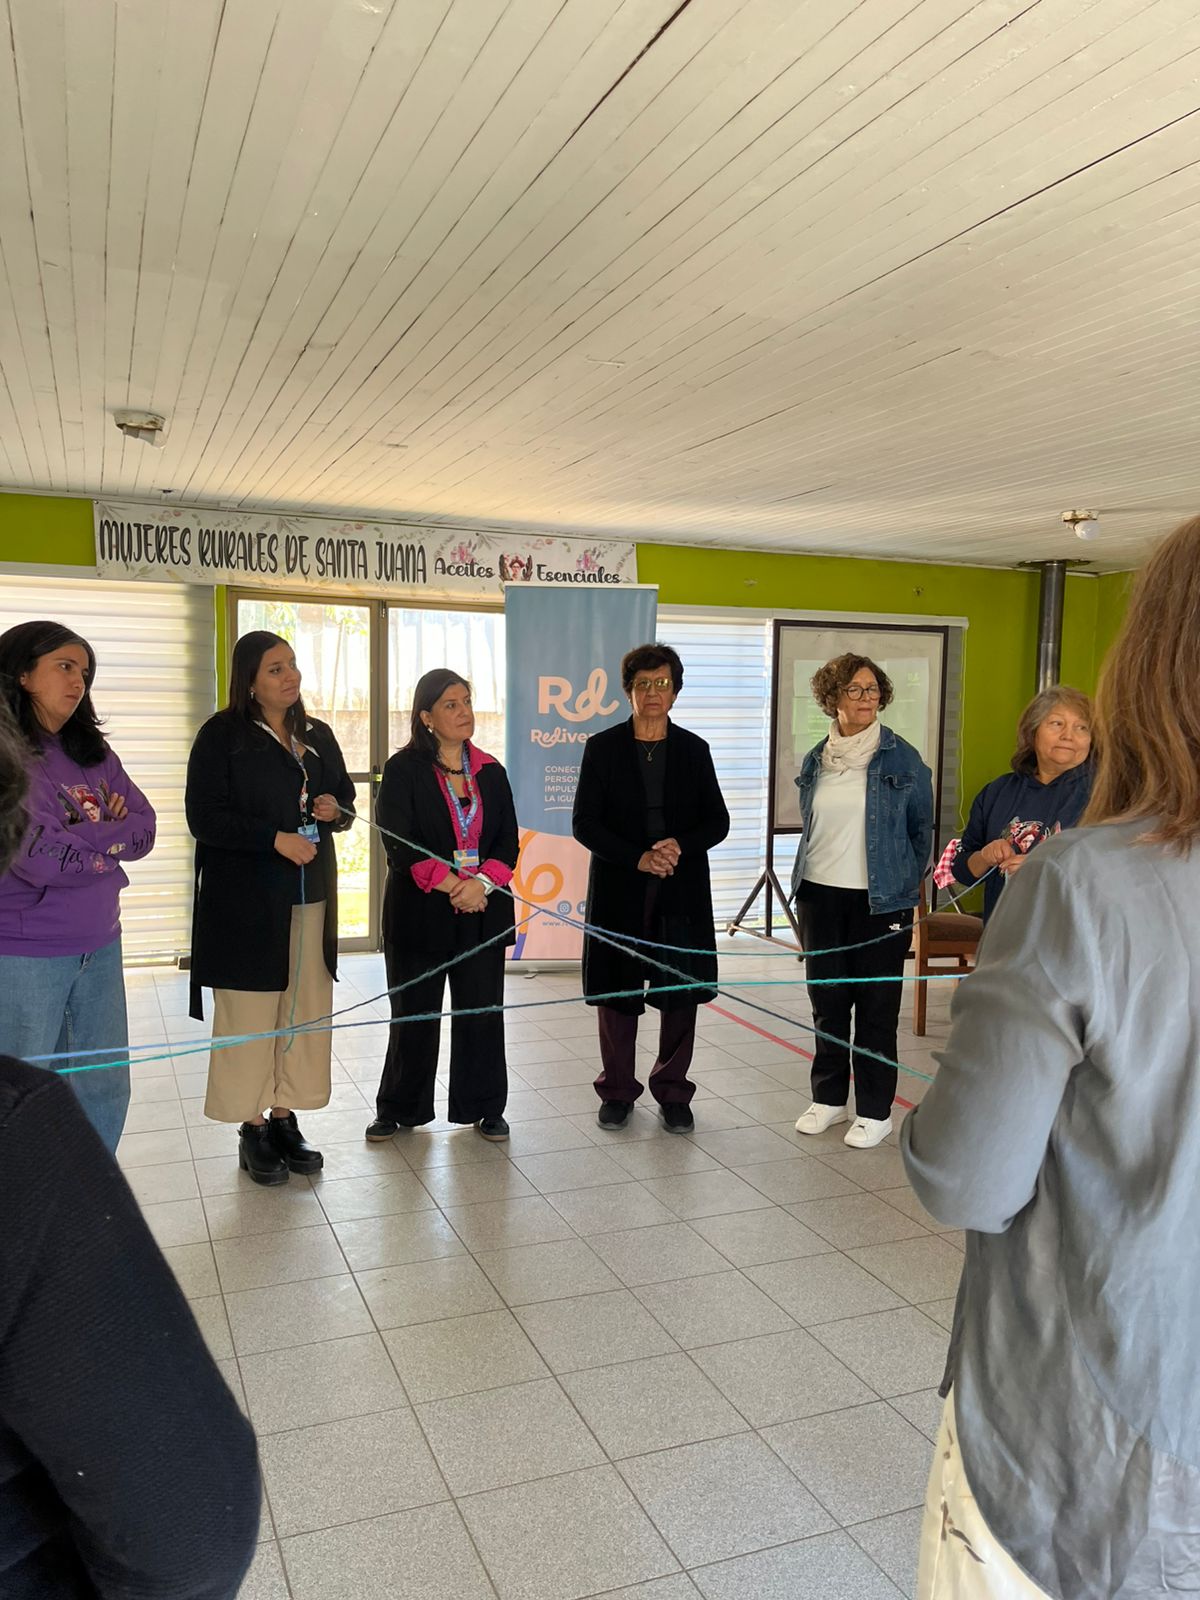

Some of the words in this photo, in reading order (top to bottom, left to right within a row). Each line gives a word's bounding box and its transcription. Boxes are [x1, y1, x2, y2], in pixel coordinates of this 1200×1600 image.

[99, 519, 192, 571] MUJERES
[199, 528, 279, 574] RURALES
[284, 534, 311, 582] DE
[315, 537, 369, 579] SANTA
[375, 541, 427, 583] JUANA
[434, 557, 496, 579] Aceites
[536, 563, 622, 584] Esenciales
